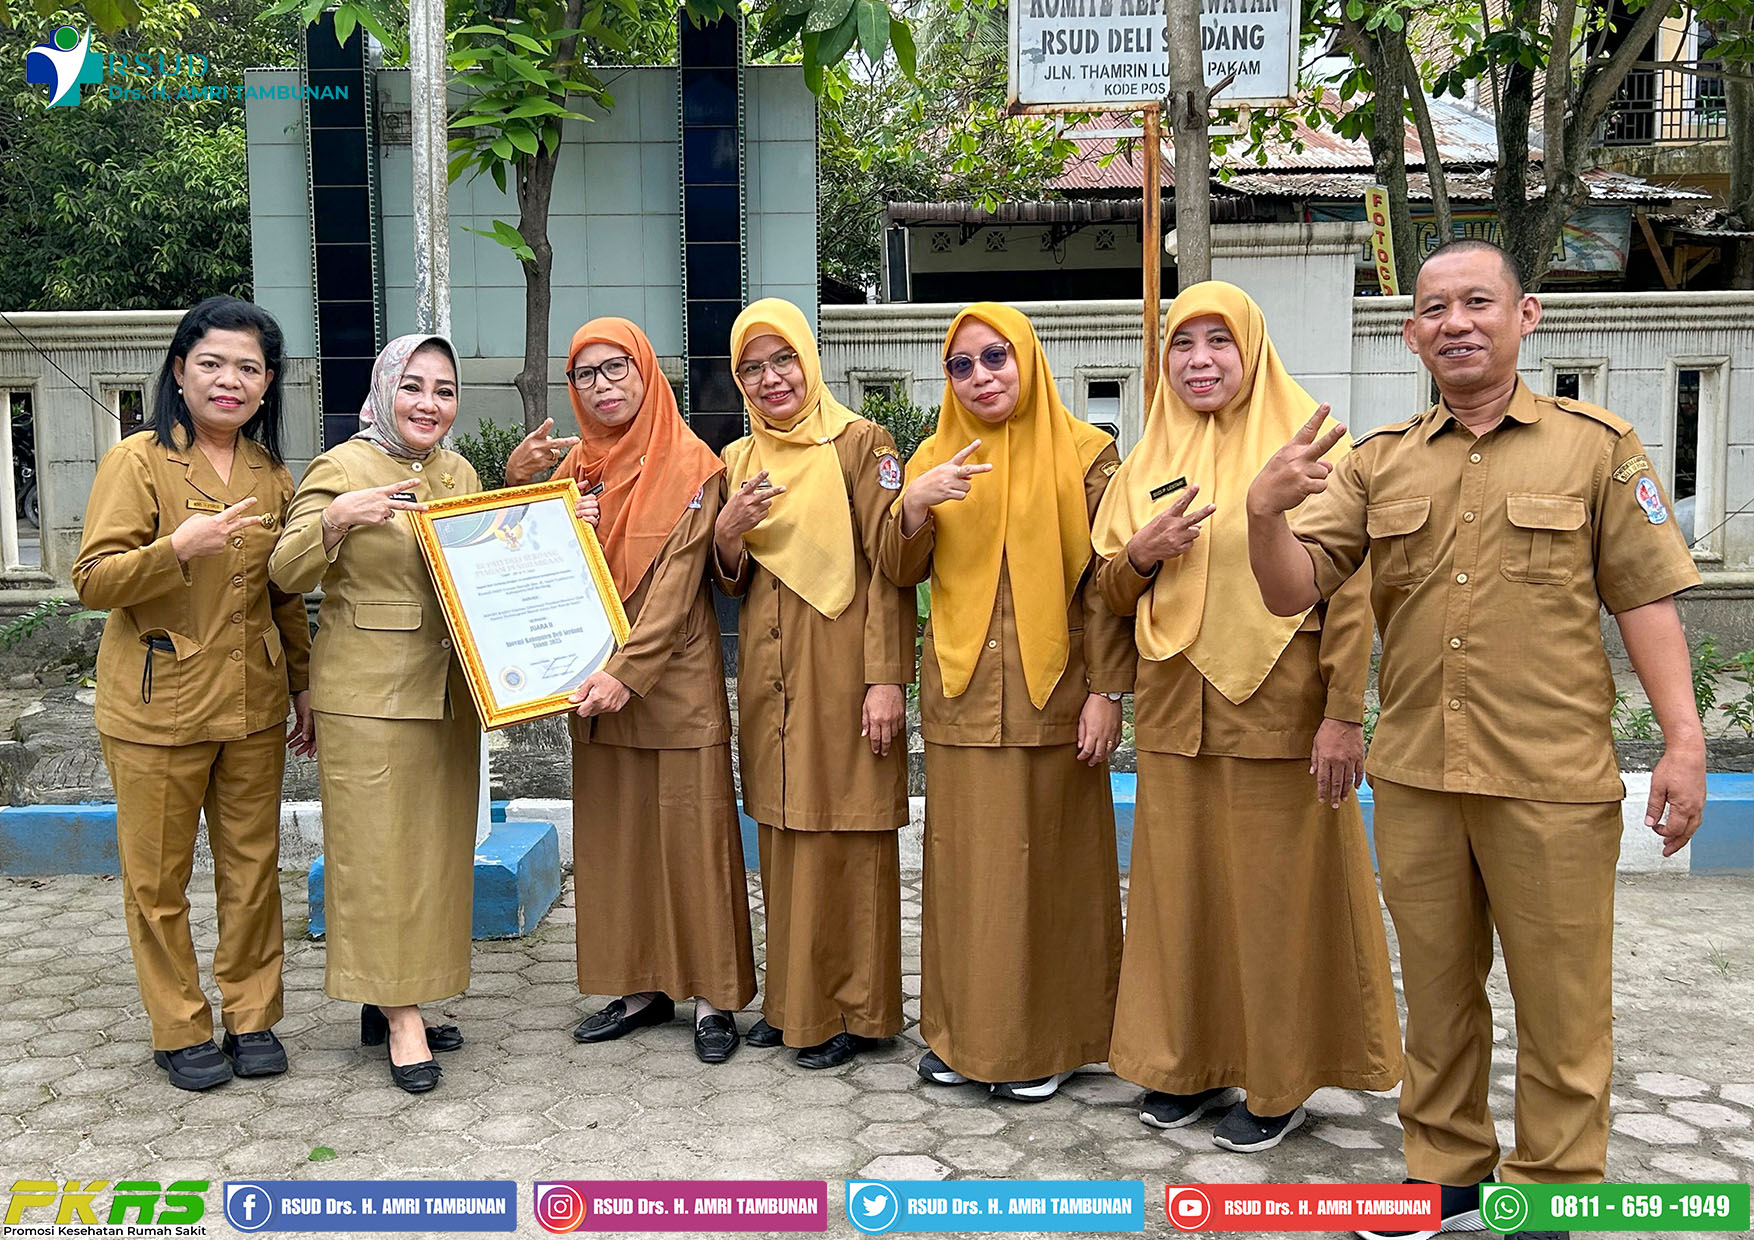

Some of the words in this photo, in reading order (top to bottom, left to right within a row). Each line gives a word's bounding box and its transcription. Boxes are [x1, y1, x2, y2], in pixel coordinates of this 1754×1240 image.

[1042, 28, 1100, 55] RSUD
[1108, 27, 1153, 53] DELI
[1161, 24, 1265, 53] SDANG
[1044, 65, 1076, 80] JLN.
[1080, 62, 1148, 79] THAMRIN
[1207, 60, 1261, 76] PAKAM
[1104, 83, 1138, 96] KODE
[1141, 82, 1166, 95] POS
